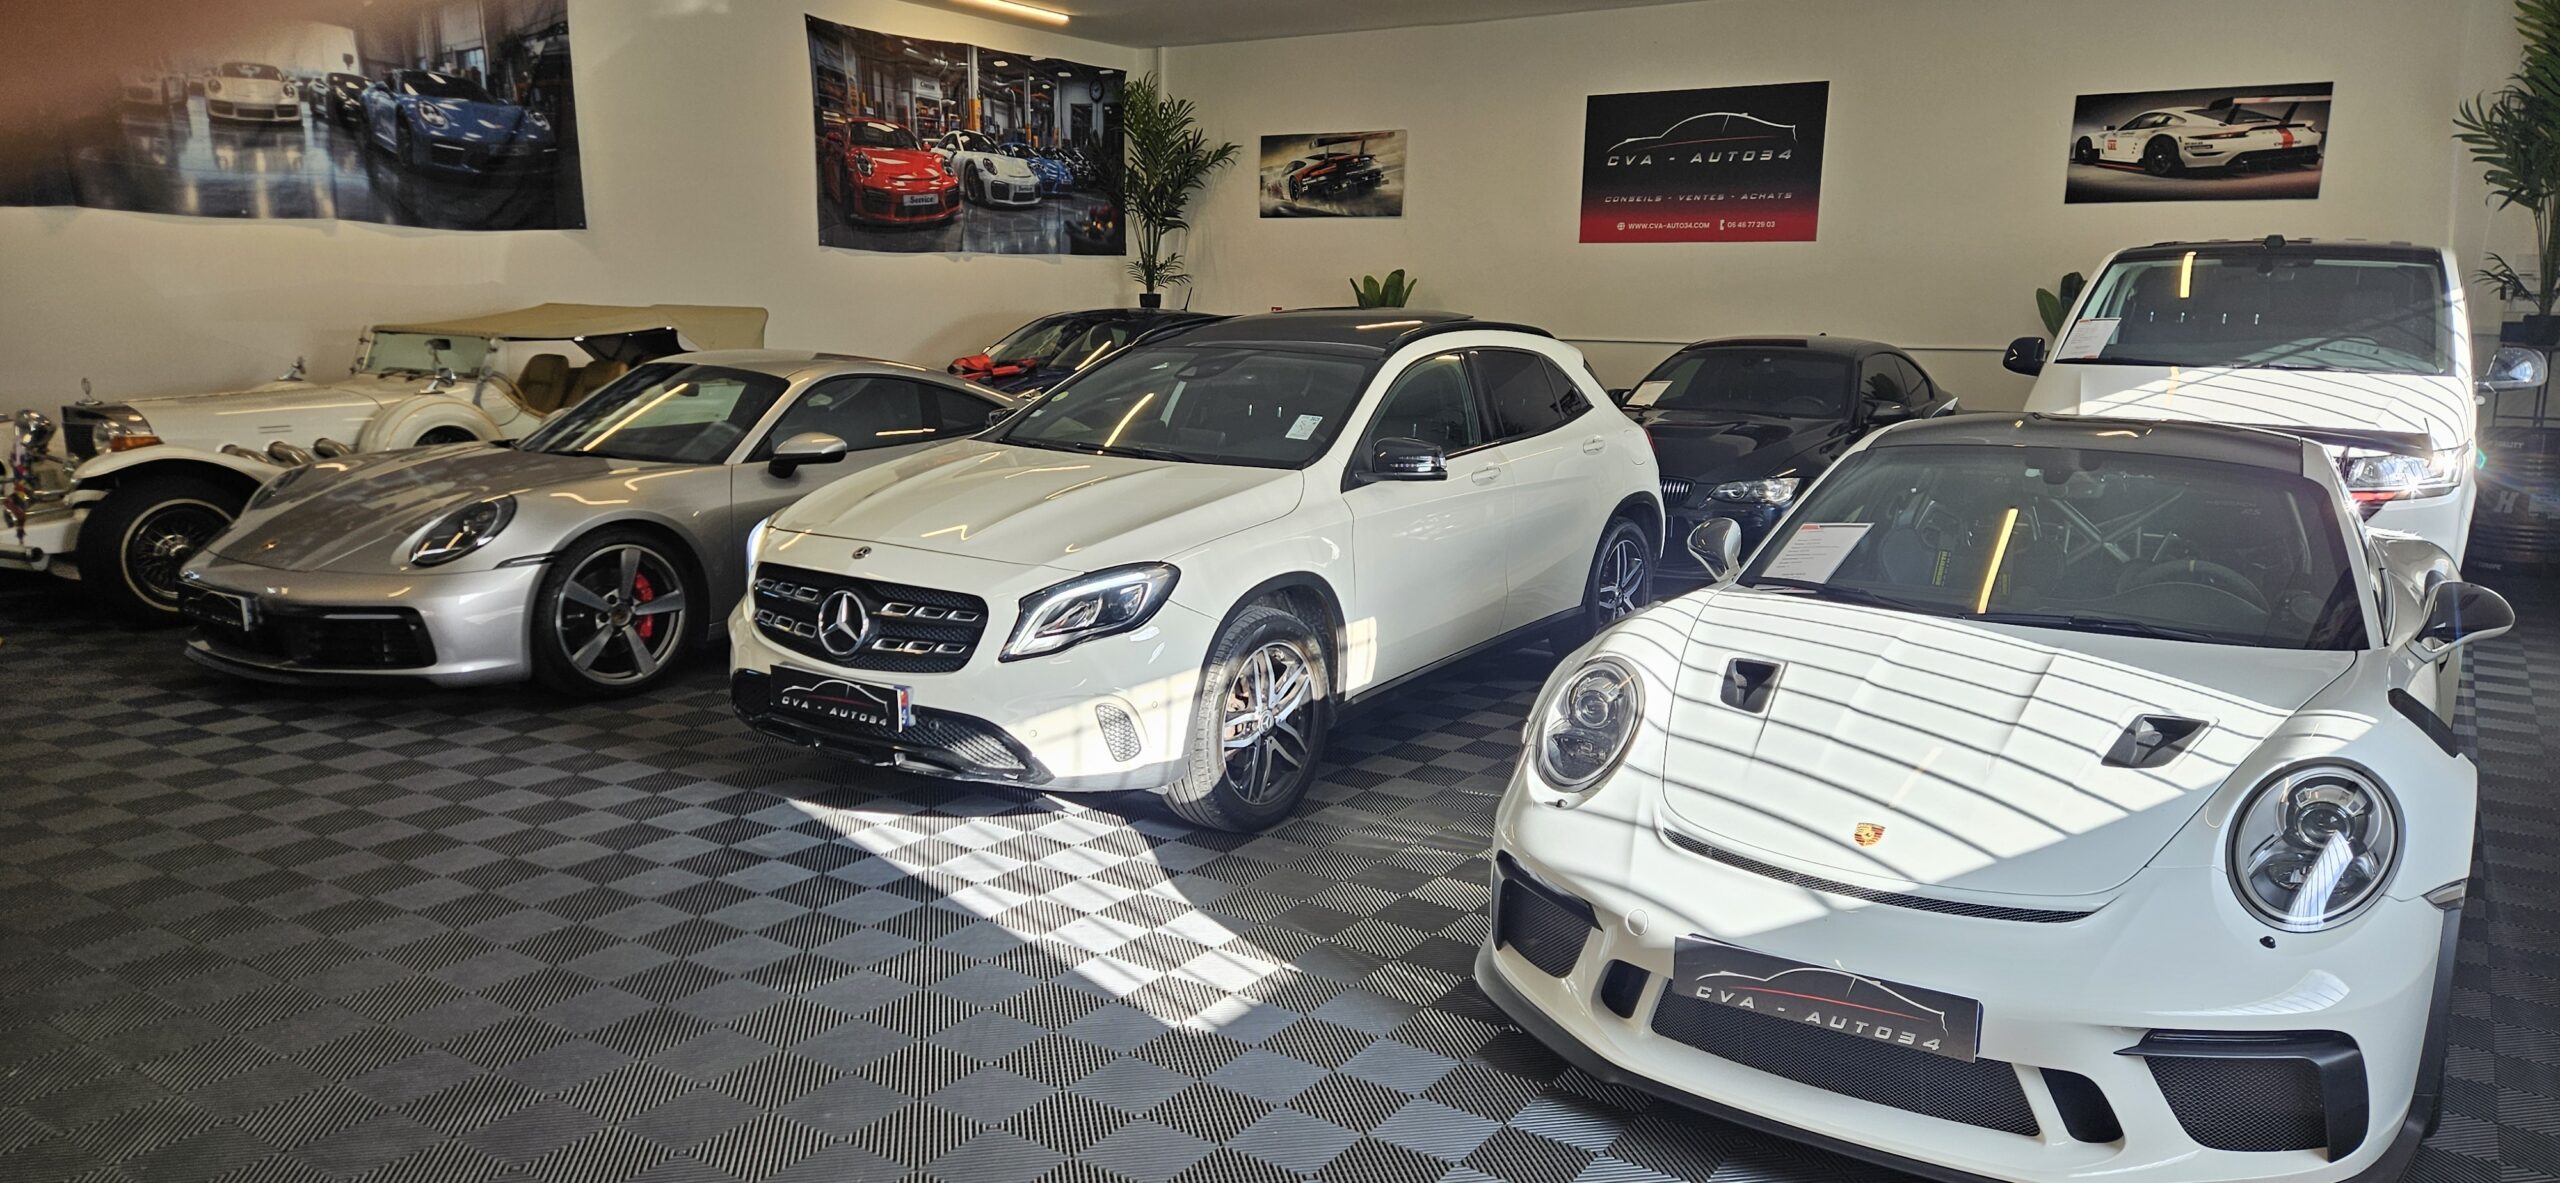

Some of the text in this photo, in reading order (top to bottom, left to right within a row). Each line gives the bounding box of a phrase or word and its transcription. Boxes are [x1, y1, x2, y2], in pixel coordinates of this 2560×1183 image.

[1607, 154, 1652, 166] CVA
[1690, 149, 1792, 163] AUTO34
[910, 195, 934, 204] Service
[1604, 195, 1662, 203] CONSEILS
[1740, 192, 1792, 200] ACHATS
[1628, 222, 1710, 230] WWW.CVA-AUTO34.COM
[781, 697, 809, 709] CVA
[829, 707, 887, 726] AUTO34
[1696, 986, 1755, 1009] CVA
[1804, 1011, 1941, 1051] AUTO34
